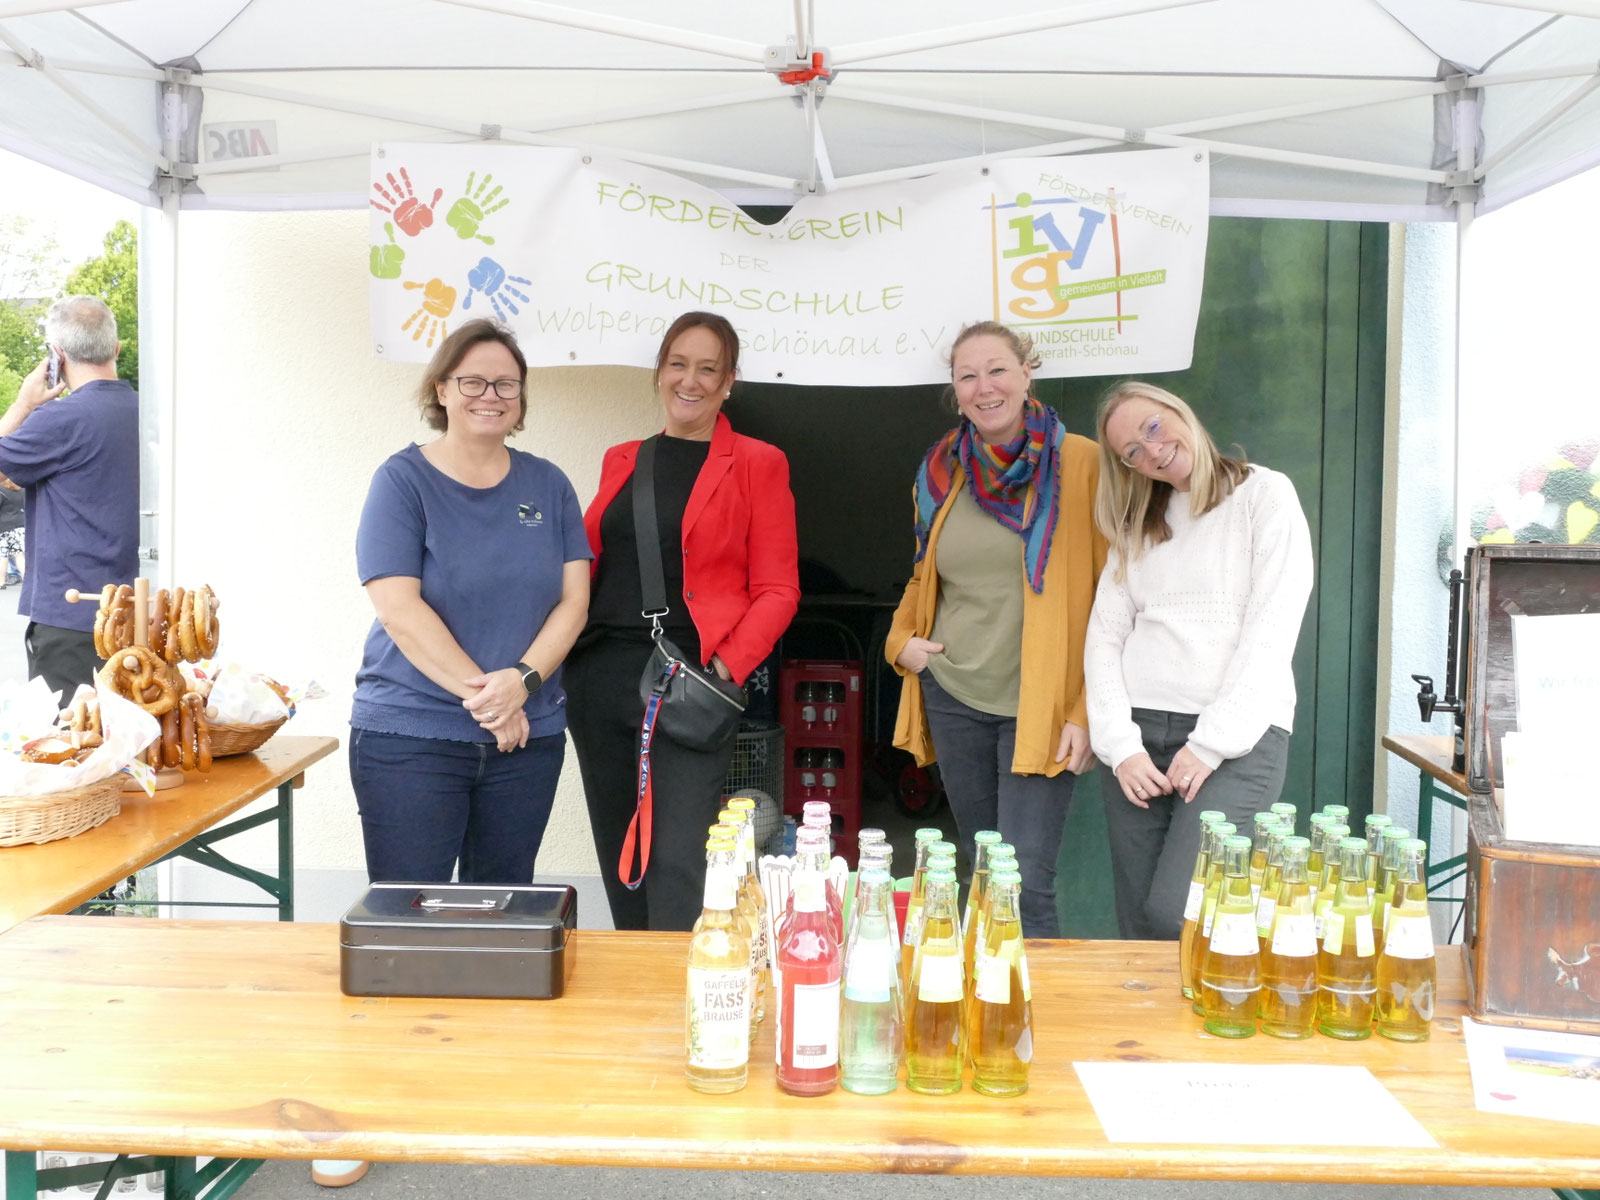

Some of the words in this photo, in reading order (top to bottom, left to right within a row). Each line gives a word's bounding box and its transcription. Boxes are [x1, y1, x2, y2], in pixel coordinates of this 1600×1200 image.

[598, 182, 903, 241] FÖRDEREREIN
[1039, 173, 1192, 236] FÖRDERVEREIN
[719, 252, 773, 274] DER
[586, 261, 904, 317] GRUNDSCHULE
[1060, 281, 1116, 299] gemeinsam
[1118, 278, 1129, 290] in
[1131, 273, 1164, 288] Vielfalt
[704, 991, 744, 1009] FASS
[704, 1009, 744, 1021] BRAUSE
